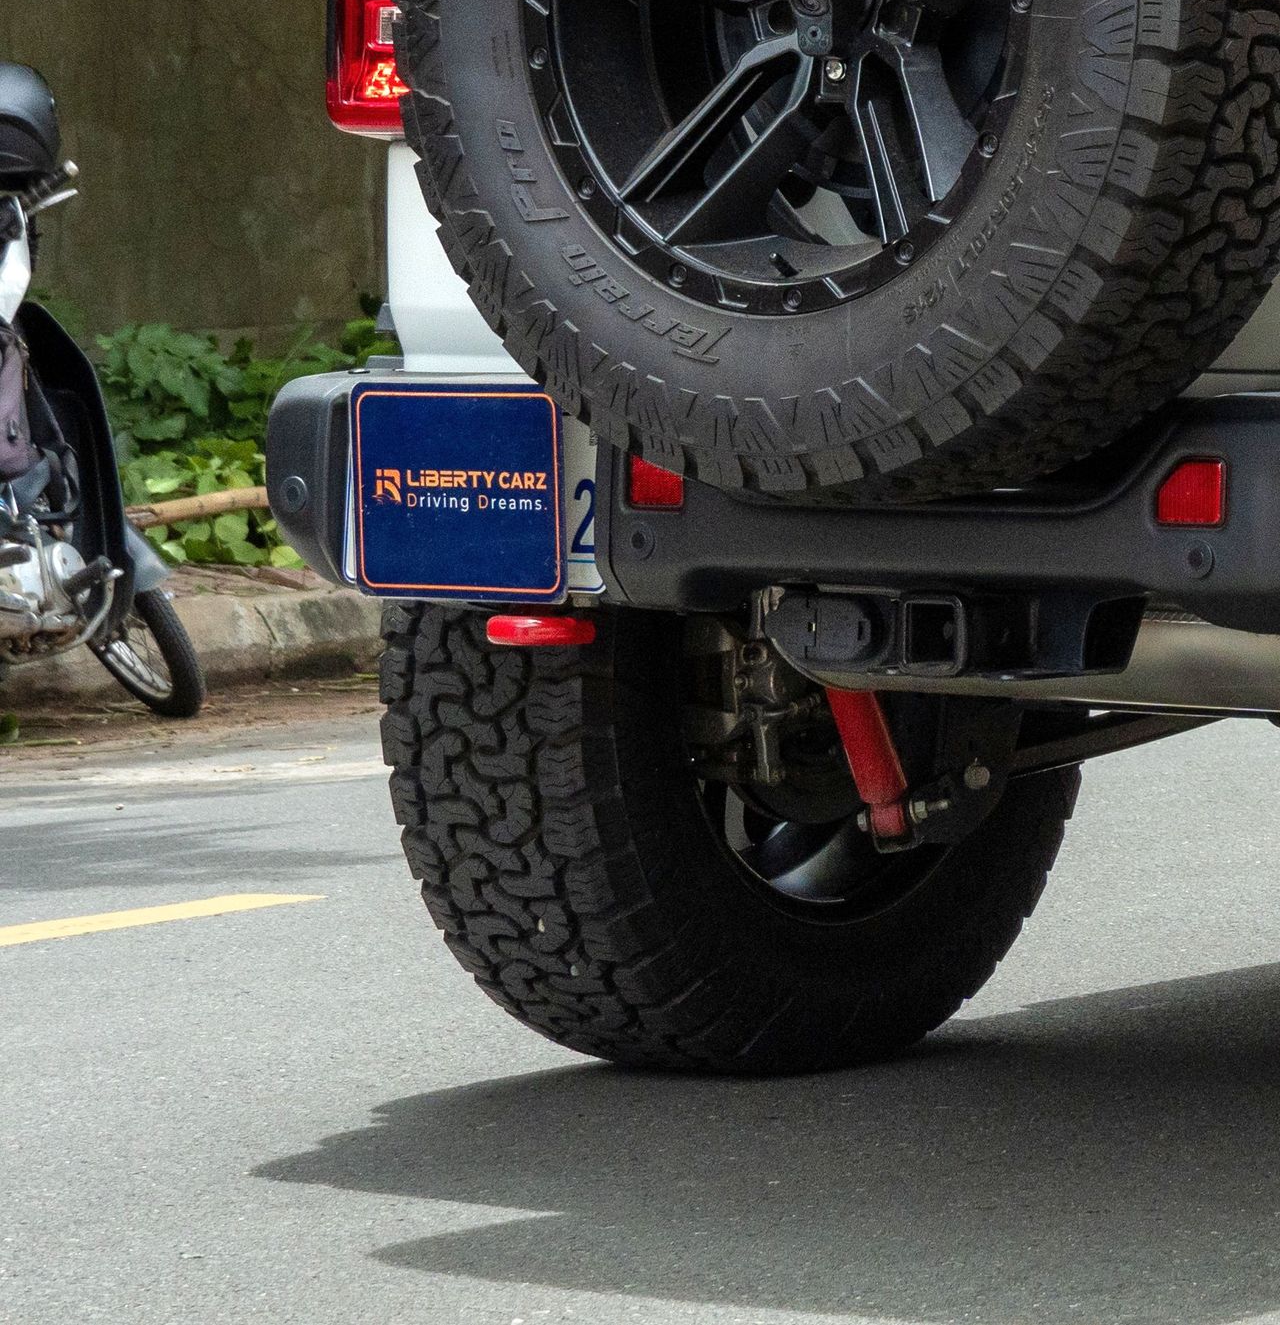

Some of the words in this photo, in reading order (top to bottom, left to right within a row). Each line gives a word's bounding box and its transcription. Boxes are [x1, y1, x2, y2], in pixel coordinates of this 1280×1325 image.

[561, 242, 734, 365] Terrain
[407, 492, 469, 512] Driving
[498, 471, 547, 490] CARZ
[571, 478, 596, 554] 2
